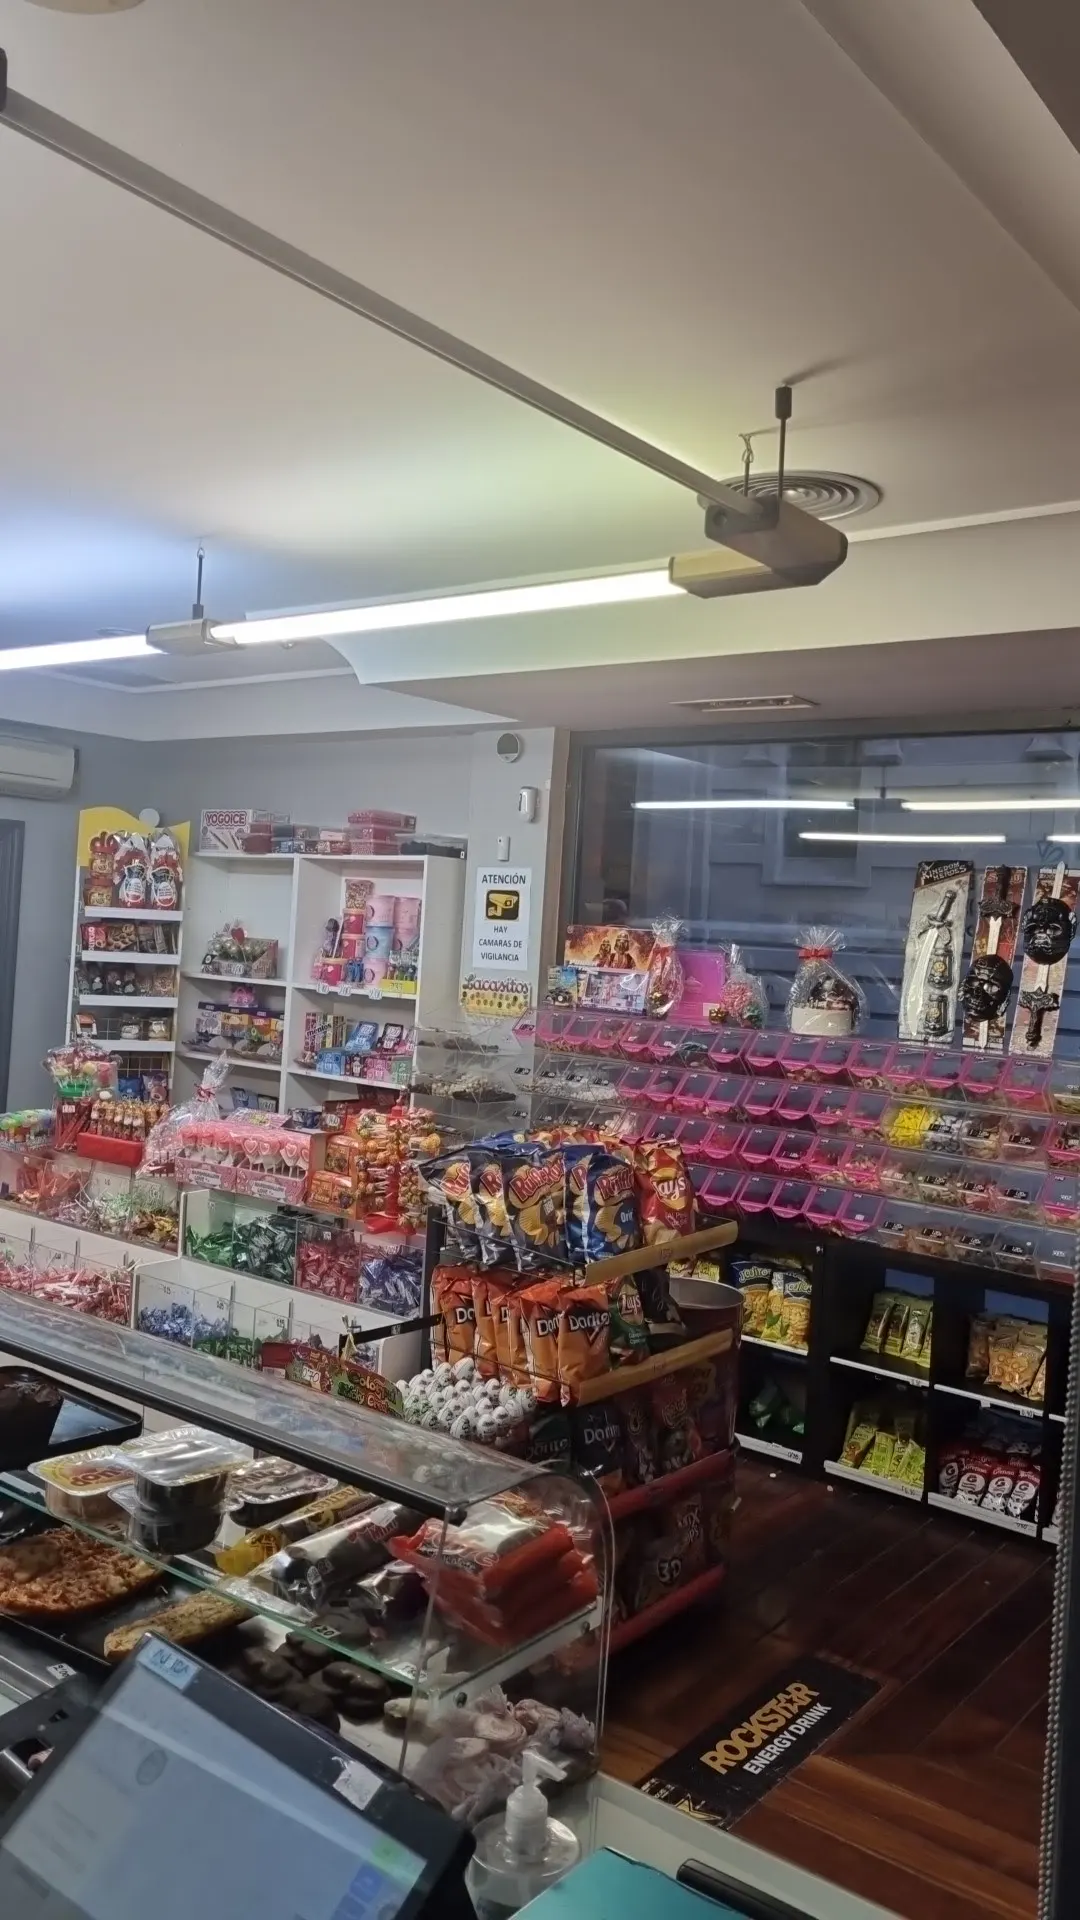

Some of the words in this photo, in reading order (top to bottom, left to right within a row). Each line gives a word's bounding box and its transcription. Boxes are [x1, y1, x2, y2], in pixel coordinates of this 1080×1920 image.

[206, 812, 246, 825] YOGOICE
[921, 862, 960, 879] KINGDOM
[481, 873, 526, 885] ATENCIÓN
[479, 939, 512, 948] CAMARAS
[513, 940, 522, 948] DE
[480, 952, 520, 961] VIGILANCIA
[463, 974, 529, 994] Lacasitos
[306, 1022, 332, 1037] mentos
[699, 1682, 820, 1775] ROCKSTAR
[743, 1730, 798, 1775] ENERGY
[791, 1702, 832, 1736] DRINK
